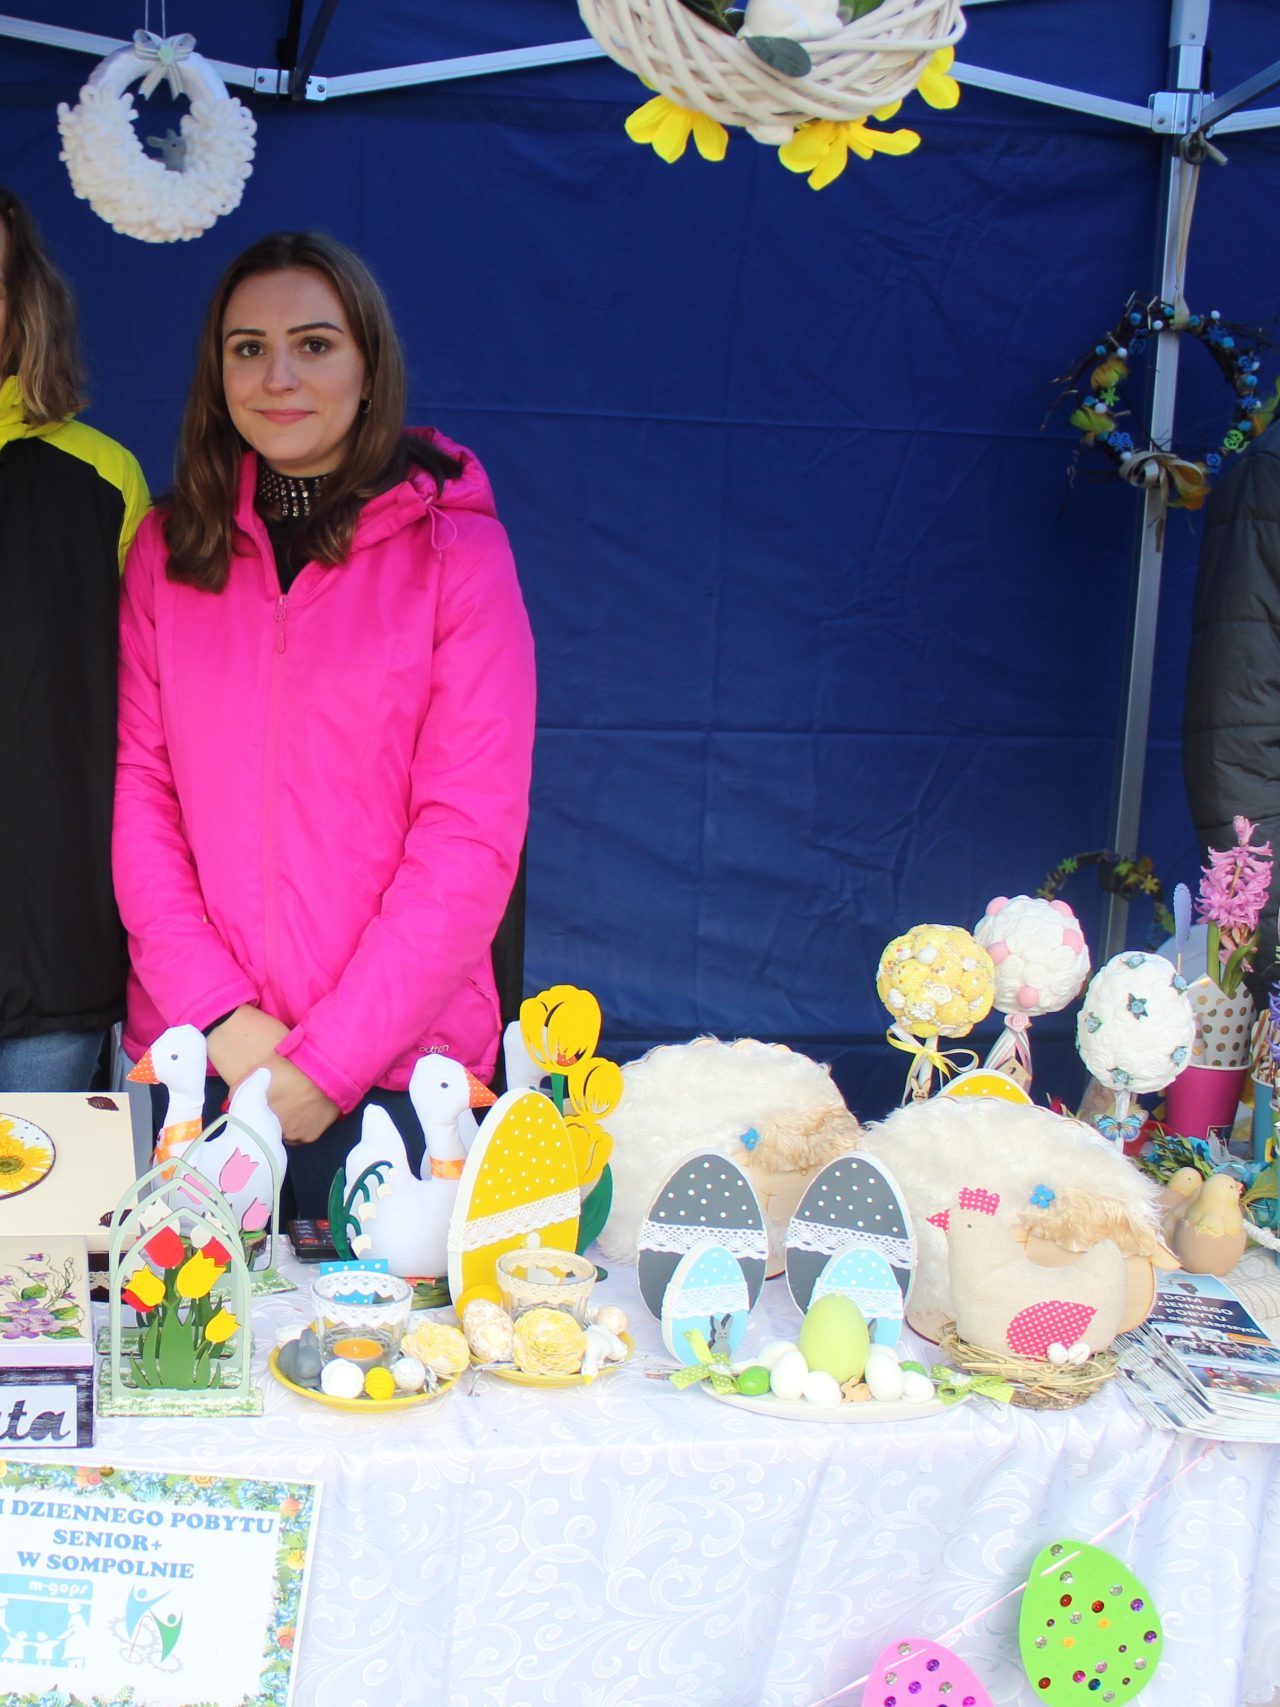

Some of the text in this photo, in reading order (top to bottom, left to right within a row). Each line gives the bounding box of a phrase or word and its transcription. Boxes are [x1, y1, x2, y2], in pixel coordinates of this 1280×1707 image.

[1154, 1300, 1233, 1316] ZIENNEGO
[1163, 1294, 1202, 1303] DOM
[1165, 1308, 1227, 1322] POBYTU
[10, 1499, 165, 1528] DZIENNEGO
[170, 1513, 276, 1535] POBYTU
[52, 1528, 163, 1552] SENIOR+
[16, 1551, 195, 1580] W SOMPOLNIE
